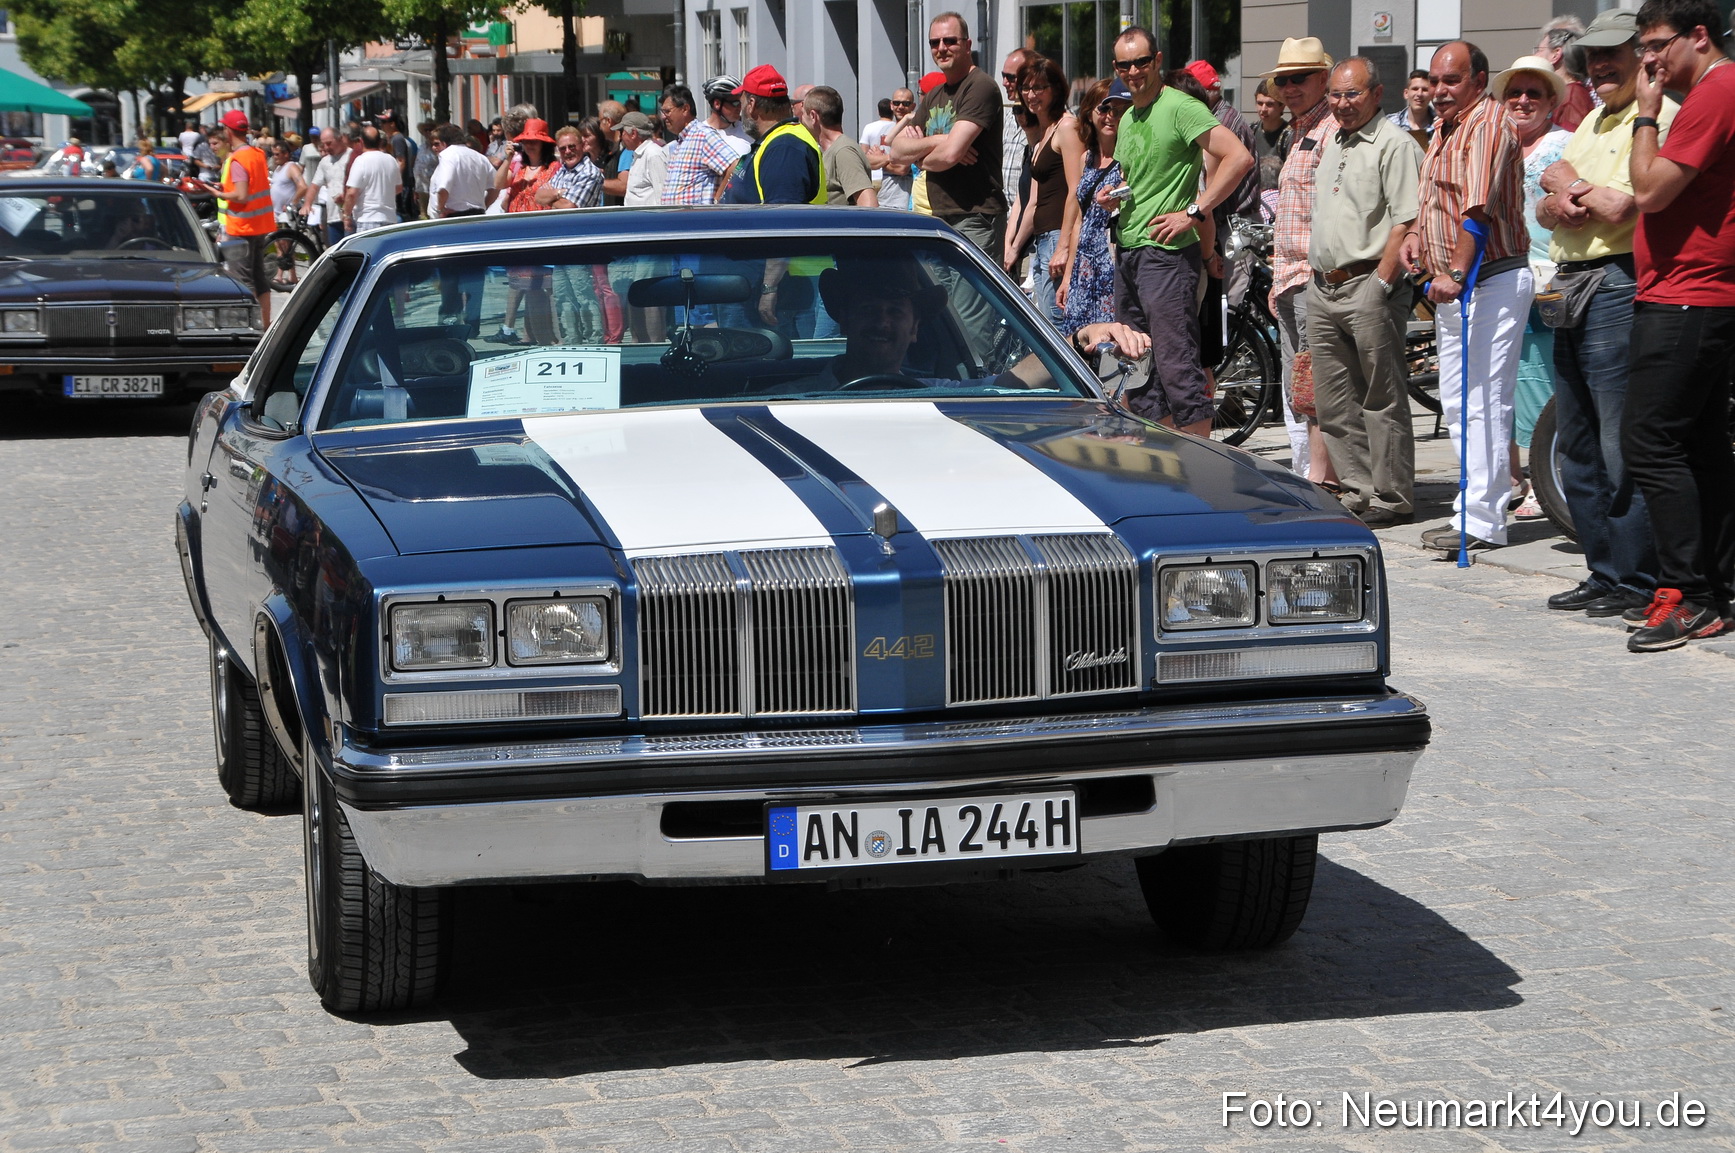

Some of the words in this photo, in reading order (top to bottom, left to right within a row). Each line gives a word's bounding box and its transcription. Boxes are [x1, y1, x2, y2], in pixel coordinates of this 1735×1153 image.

[537, 362, 583, 376] 211
[74, 377, 91, 392] EI
[101, 377, 120, 392] CR
[863, 634, 935, 660] 442
[803, 811, 859, 861] AN
[896, 807, 946, 856] IA
[958, 798, 1071, 852] 244H
[778, 845, 790, 858] D
